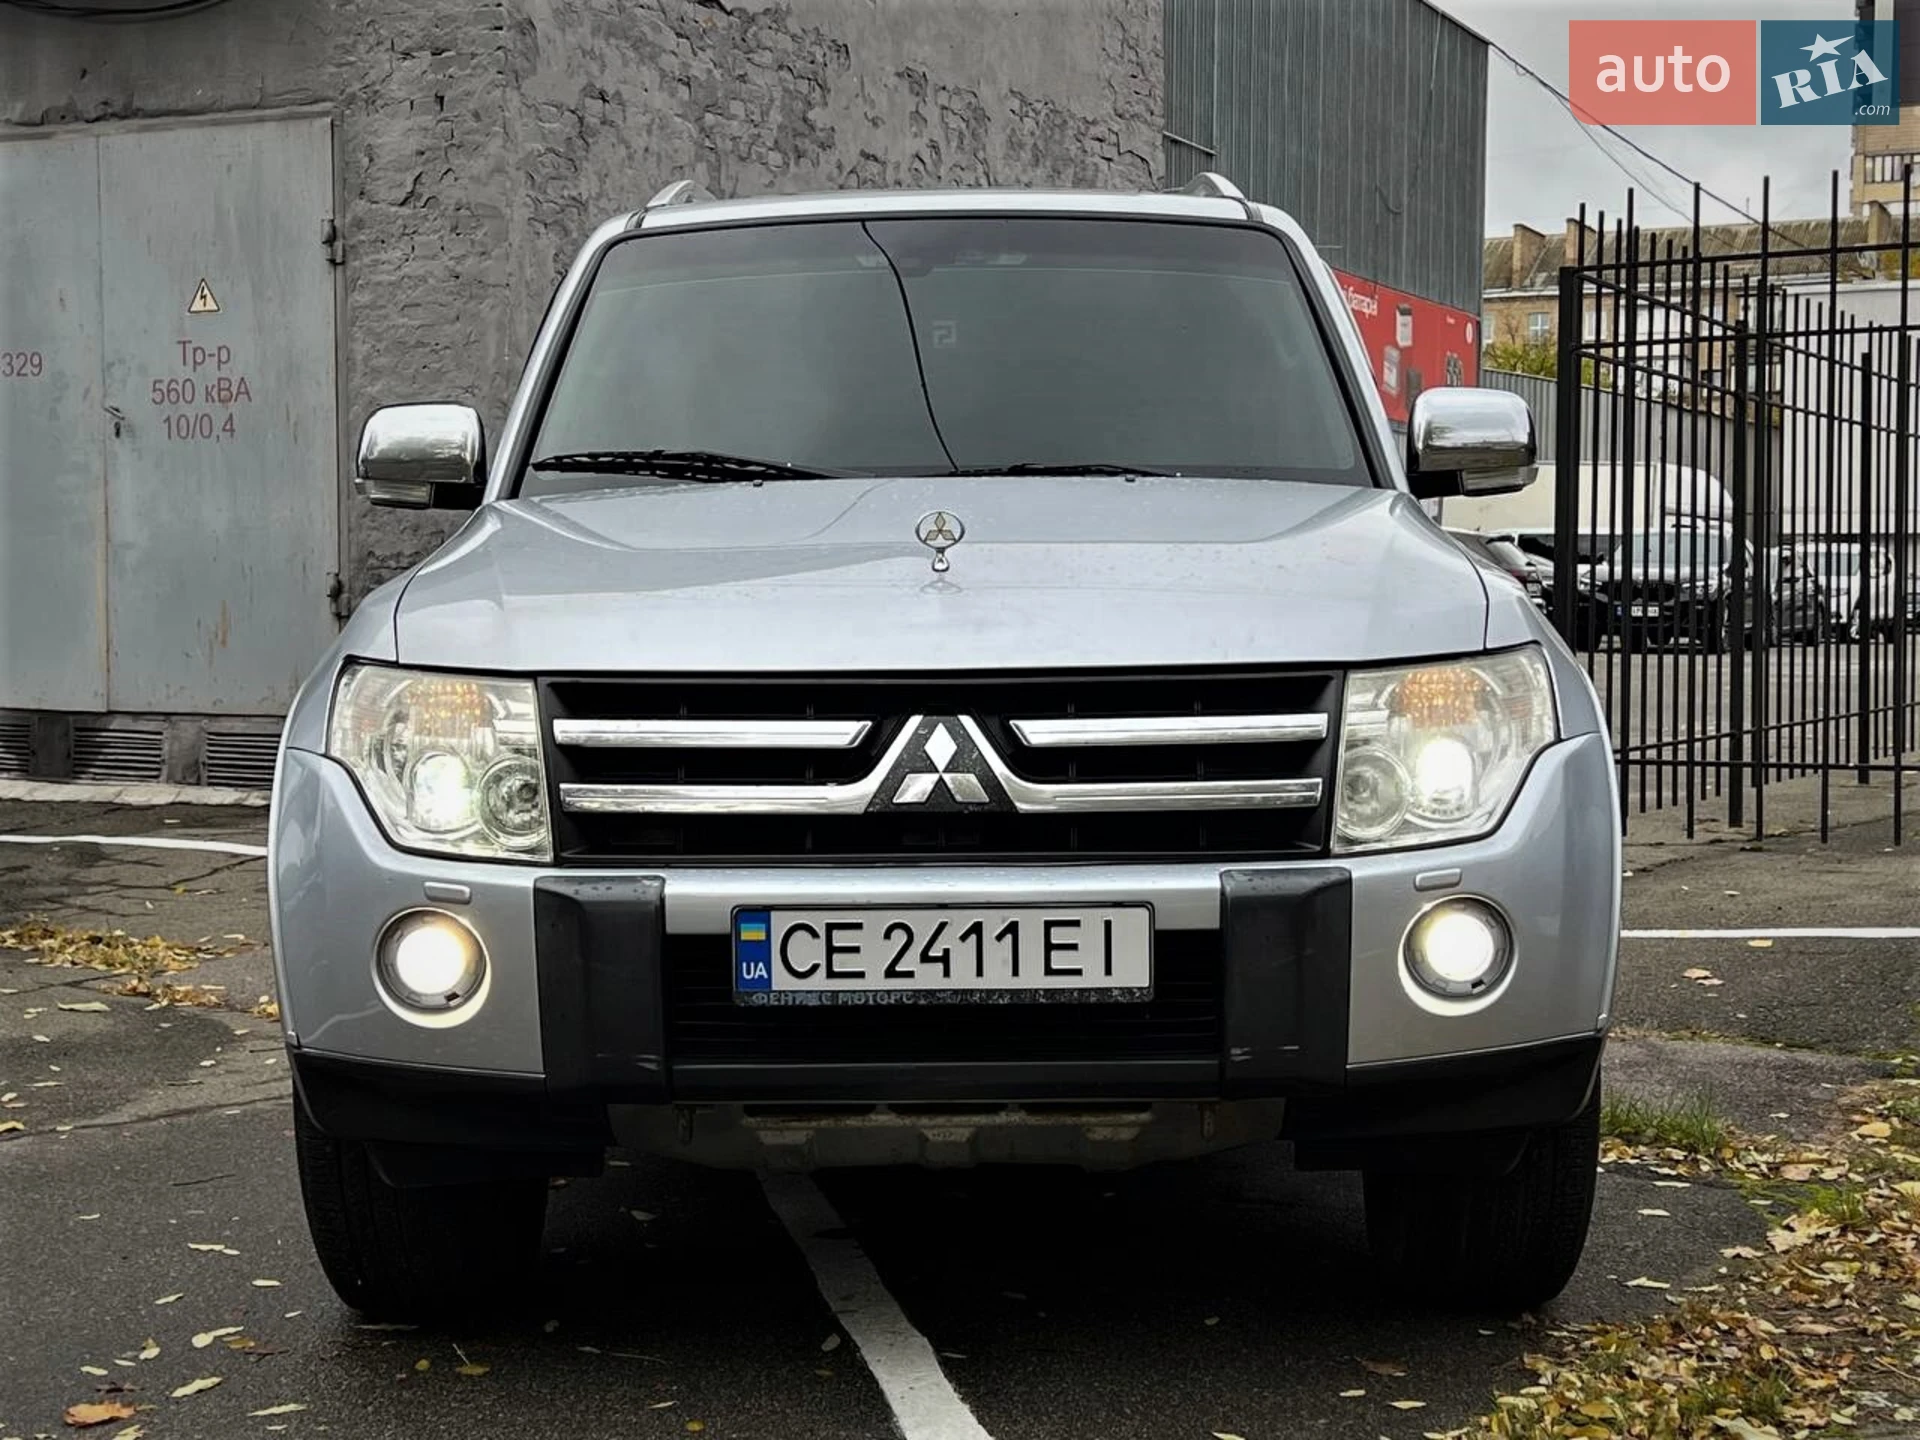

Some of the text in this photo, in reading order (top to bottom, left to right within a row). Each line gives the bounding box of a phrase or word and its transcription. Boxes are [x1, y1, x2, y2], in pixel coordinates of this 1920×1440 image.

[2, 351, 43, 377] 329
[176, 340, 231, 372] Тр-р
[152, 377, 252, 405] 560 кВА
[163, 412, 236, 443] 10/0,4
[780, 918, 1113, 979] CE 2411 EI
[742, 962, 769, 979] UA
